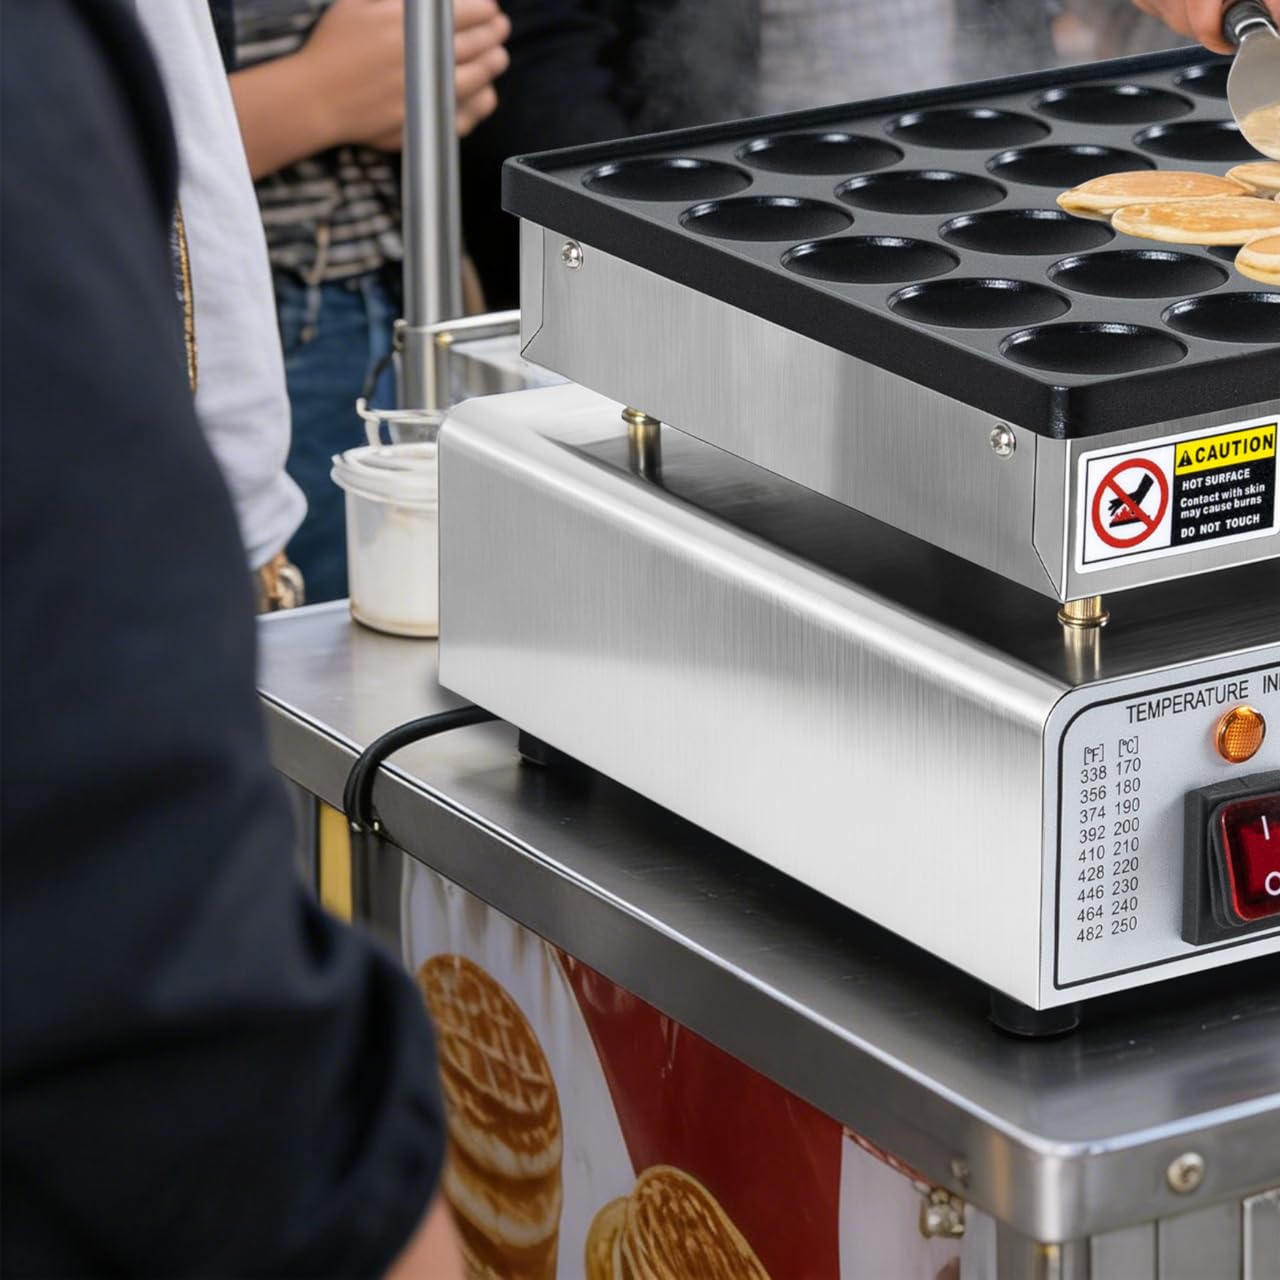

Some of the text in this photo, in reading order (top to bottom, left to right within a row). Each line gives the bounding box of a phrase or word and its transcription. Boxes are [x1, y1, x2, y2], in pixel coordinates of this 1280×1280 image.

[1195, 433, 1273, 462] CAUTION
[1182, 468, 1250, 490] HOT SURFACE
[1180, 483, 1265, 507] Contact with skin
[1180, 495, 1262, 518] may cause burns
[1181, 514, 1260, 538] DO NOT TOUCH
[1126, 679, 1250, 725] TEMPERATURE
[1080, 756, 1142, 785] 338 170
[1080, 776, 1141, 805] 356 180
[1079, 796, 1141, 825] 374 190
[1079, 816, 1140, 845] 392 200
[1078, 836, 1140, 864] 410 210
[1077, 856, 1139, 883] 428 220
[1076, 876, 1139, 903] 446 230
[1076, 896, 1139, 923] 464 240
[1076, 915, 1138, 943] 482 250
